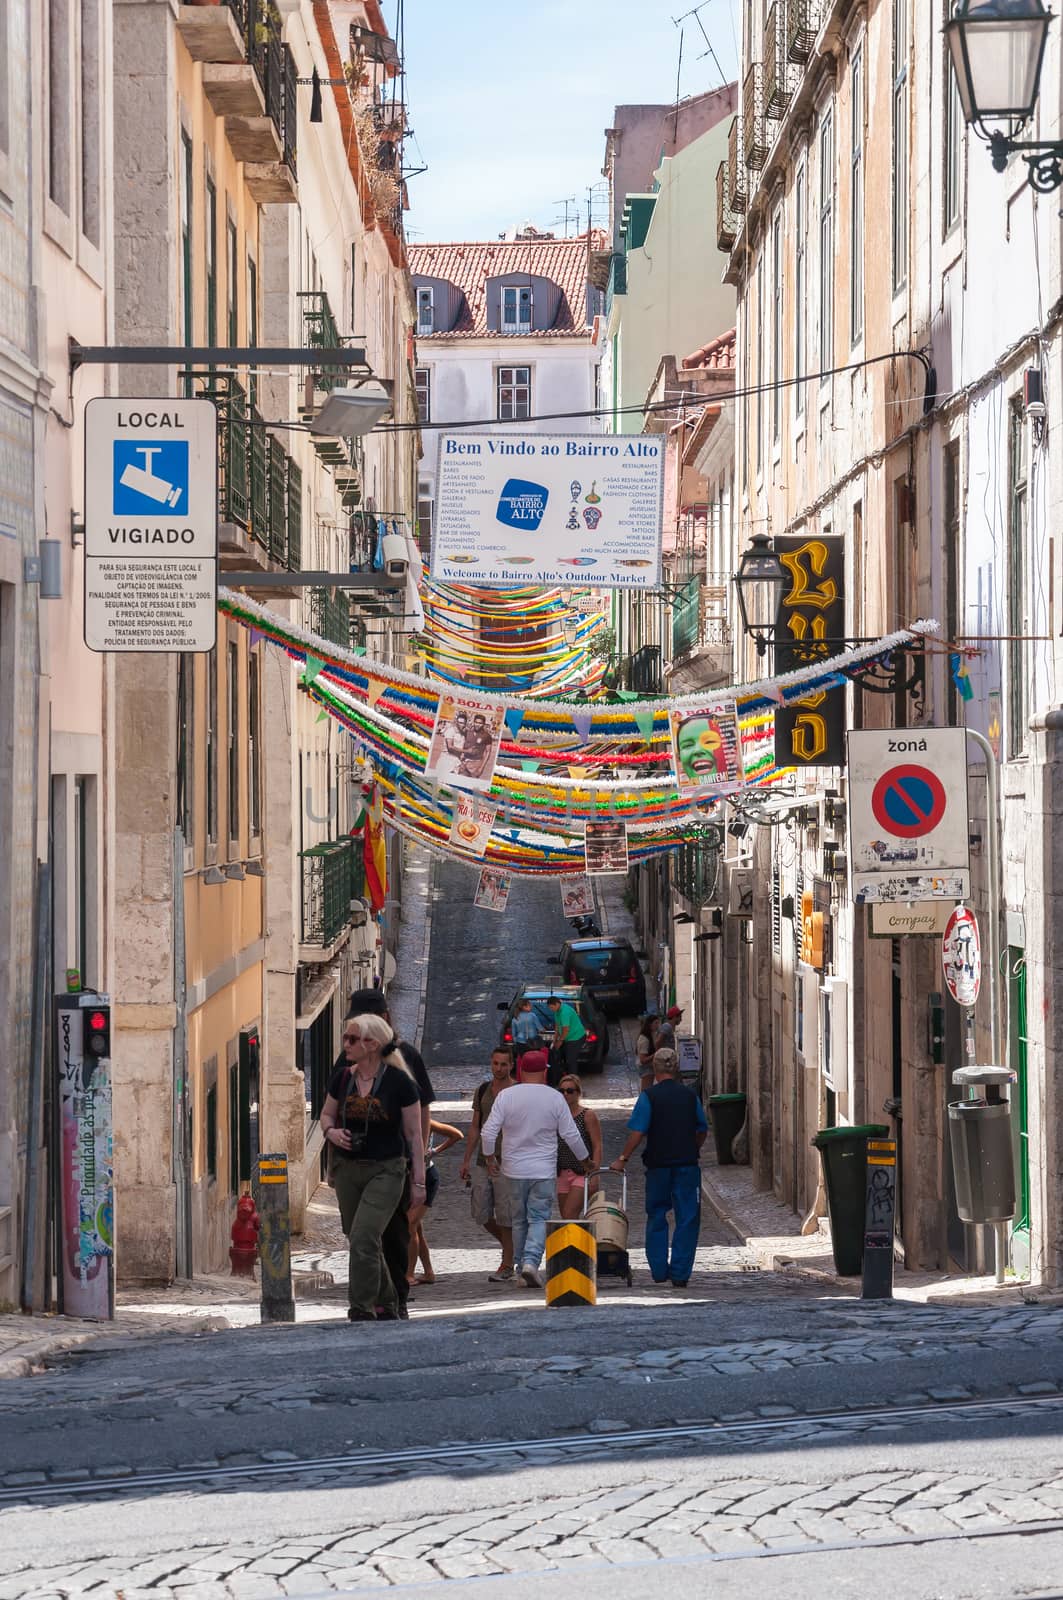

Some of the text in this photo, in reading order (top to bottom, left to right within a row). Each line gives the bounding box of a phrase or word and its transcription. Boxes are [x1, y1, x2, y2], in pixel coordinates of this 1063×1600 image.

[118, 412, 185, 428] LOCAL
[446, 440, 658, 457] Bem Vindo ao Bairro Alto
[511, 500, 543, 509] BAIRRO
[511, 509, 545, 519] ALTO
[108, 528, 195, 544] VIGIADO
[128, 564, 162, 572] SEGURANÇA
[104, 573, 125, 581] OBJETO
[126, 573, 134, 581] DE
[184, 573, 197, 581] COM
[443, 568, 646, 583] Welcome to Bairro Alto's Outdoor Market
[117, 581, 184, 591] CAPTAÇÃO DE IMAGENS.
[104, 601, 139, 609] SEGURANÇA
[121, 609, 154, 619] PREVENÇÃO
[128, 638, 136, 646] DE
[137, 638, 171, 647] SEGURANÇA
[457, 697, 494, 711] BOLA
[685, 705, 725, 717] BOLA
[888, 740, 928, 753] zona
[80, 1132, 95, 1196] Prioridade
